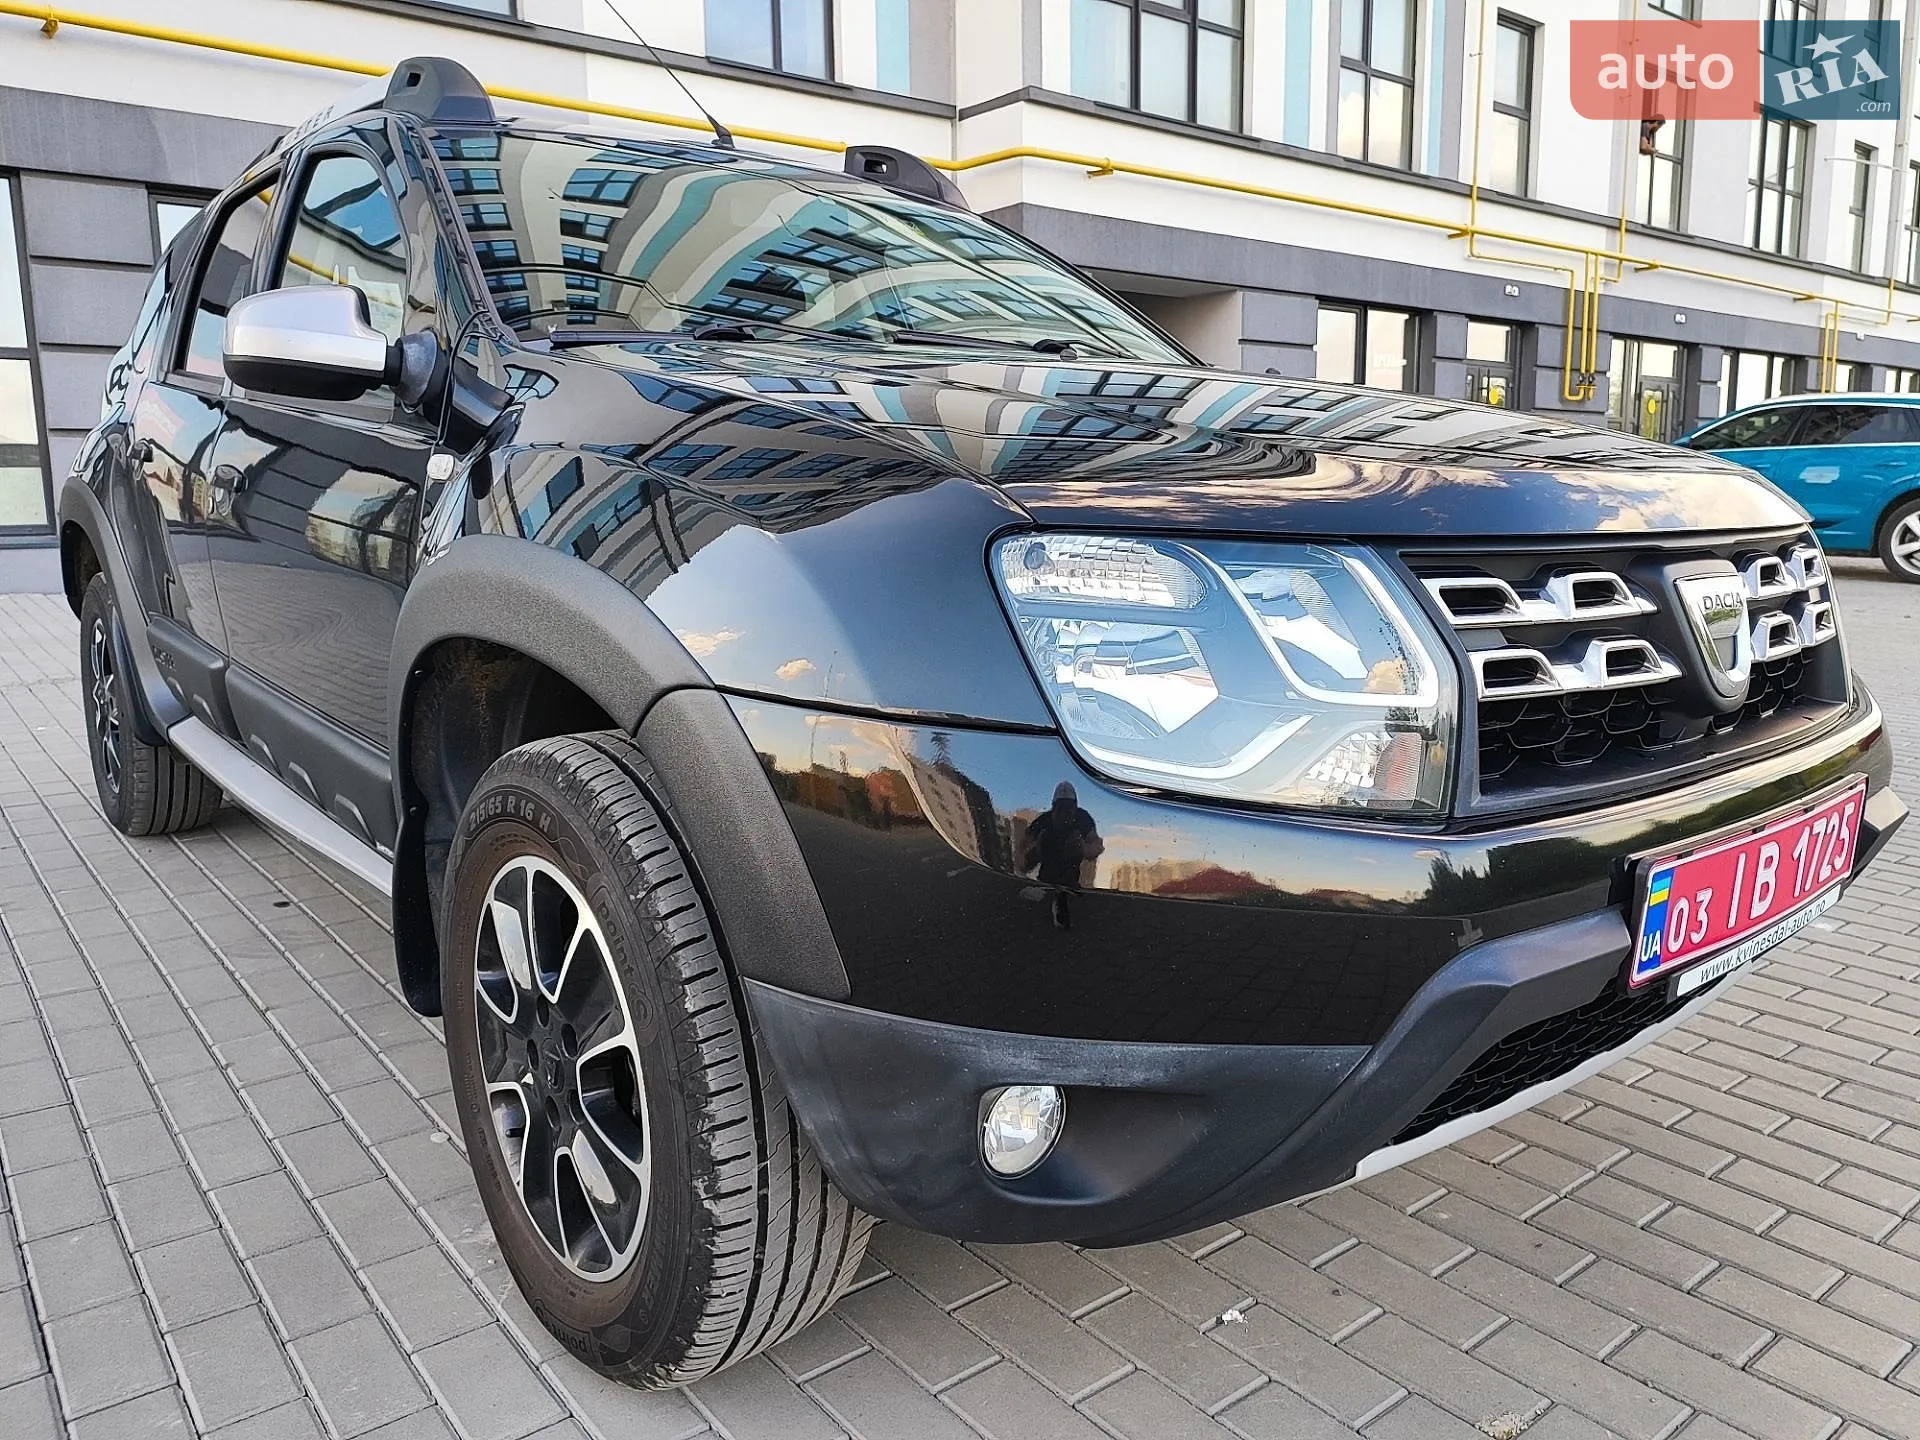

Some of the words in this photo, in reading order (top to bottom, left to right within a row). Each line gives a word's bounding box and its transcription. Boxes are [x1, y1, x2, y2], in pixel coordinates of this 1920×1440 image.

[1702, 591, 1743, 611] DACIA
[520, 800, 535, 820] 16
[1667, 888, 1713, 953] 03
[1727, 841, 1780, 929] IB
[1792, 801, 1855, 898] 1725
[1641, 931, 1661, 962] UA
[1700, 899, 1826, 982] www.kvinesdal-auto.no
